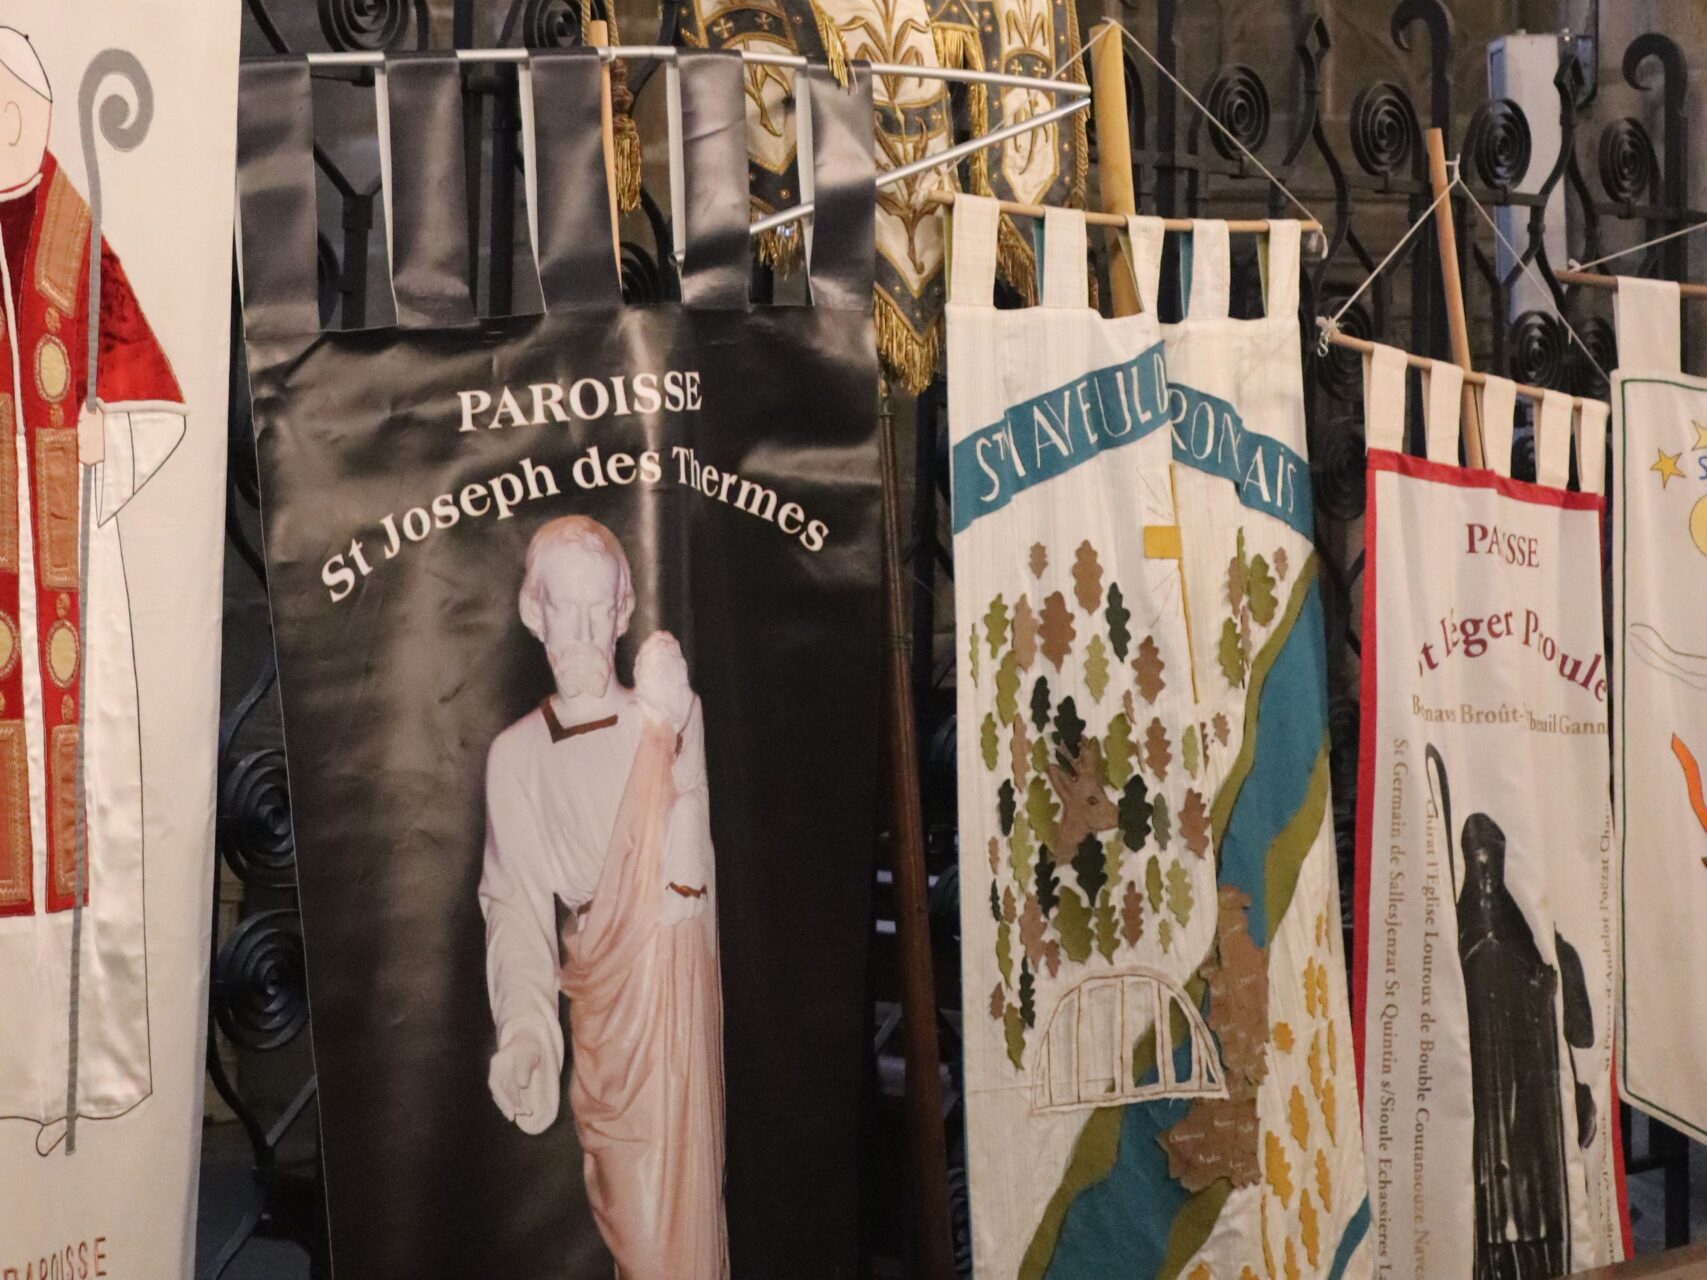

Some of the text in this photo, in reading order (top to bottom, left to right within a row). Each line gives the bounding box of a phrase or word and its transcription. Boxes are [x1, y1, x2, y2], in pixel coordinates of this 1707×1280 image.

[457, 371, 702, 432] PAROISSE
[321, 445, 829, 603] St Joseph des Thermes
[1391, 762, 1408, 837] Germain
[1390, 845, 1405, 865] de
[1385, 980, 1400, 997] St
[1421, 932, 1439, 1005] Louroux
[1380, 1003, 1400, 1074] Quintin
[1420, 1012, 1436, 1033] de
[1417, 1040, 1435, 1101] Bouble
[1379, 1080, 1396, 1151] s/Sioule
[1378, 1158, 1393, 1257] Echassieres
